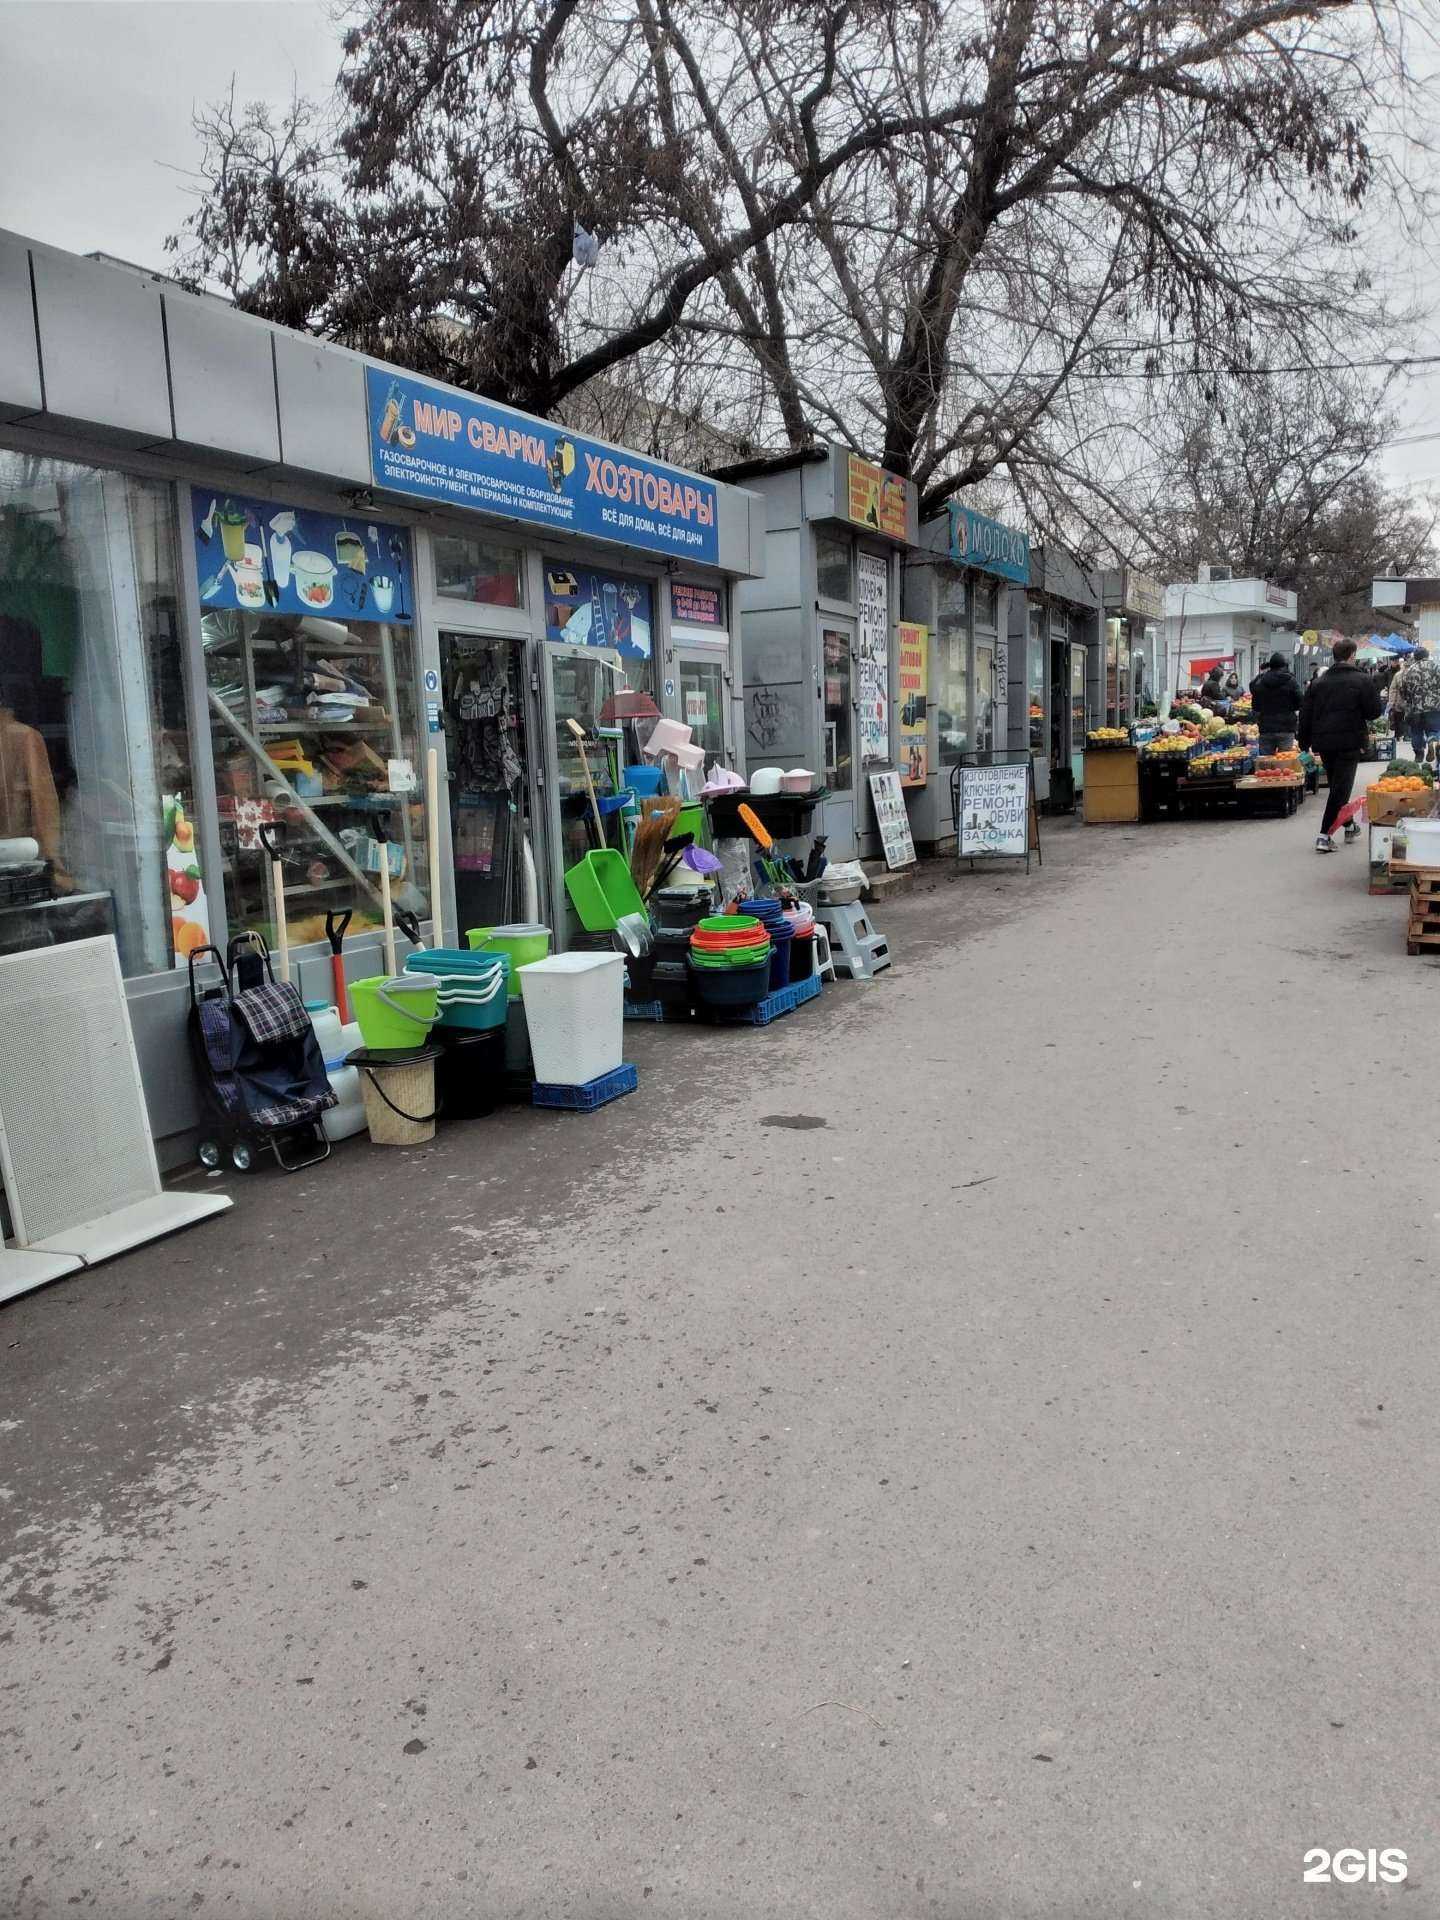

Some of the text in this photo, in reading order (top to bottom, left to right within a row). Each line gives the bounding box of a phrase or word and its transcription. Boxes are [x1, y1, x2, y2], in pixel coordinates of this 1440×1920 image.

[413, 400, 547, 467] МИР СВАРКИ
[379, 449, 447, 476] ГАЗОСВАРОЧНОЕ
[448, 467, 454, 476] И
[455, 468, 525, 496] ЭЛЕКТРОСВАРОЧНОЕ
[470, 484, 512, 506] МАТЕРИАЛЫ
[512, 496, 518, 505] И
[518, 498, 573, 519] КОМПЛЕКТУЮЩИЕ
[584, 452, 714, 527] ХОЗТОВАРЫ
[602, 508, 703, 546] ВСЁ ДЛЯ ДОМА, ВСЁ ДЛЯ ДАЧИ
[972, 519, 1025, 566] МОЛОКО
[859, 603, 886, 629] РЕМОНТ
[859, 662, 887, 685] РЕМОНТ
[964, 768, 1024, 782] ИЗГОТОВЛЕНИЕ
[964, 781, 1001, 797] КЛЮЧЕЙ
[963, 796, 1024, 810] РЕМОНТ
[991, 809, 1024, 824] ОБУВИ
[963, 828, 1024, 841] ЗАТОЧКА
